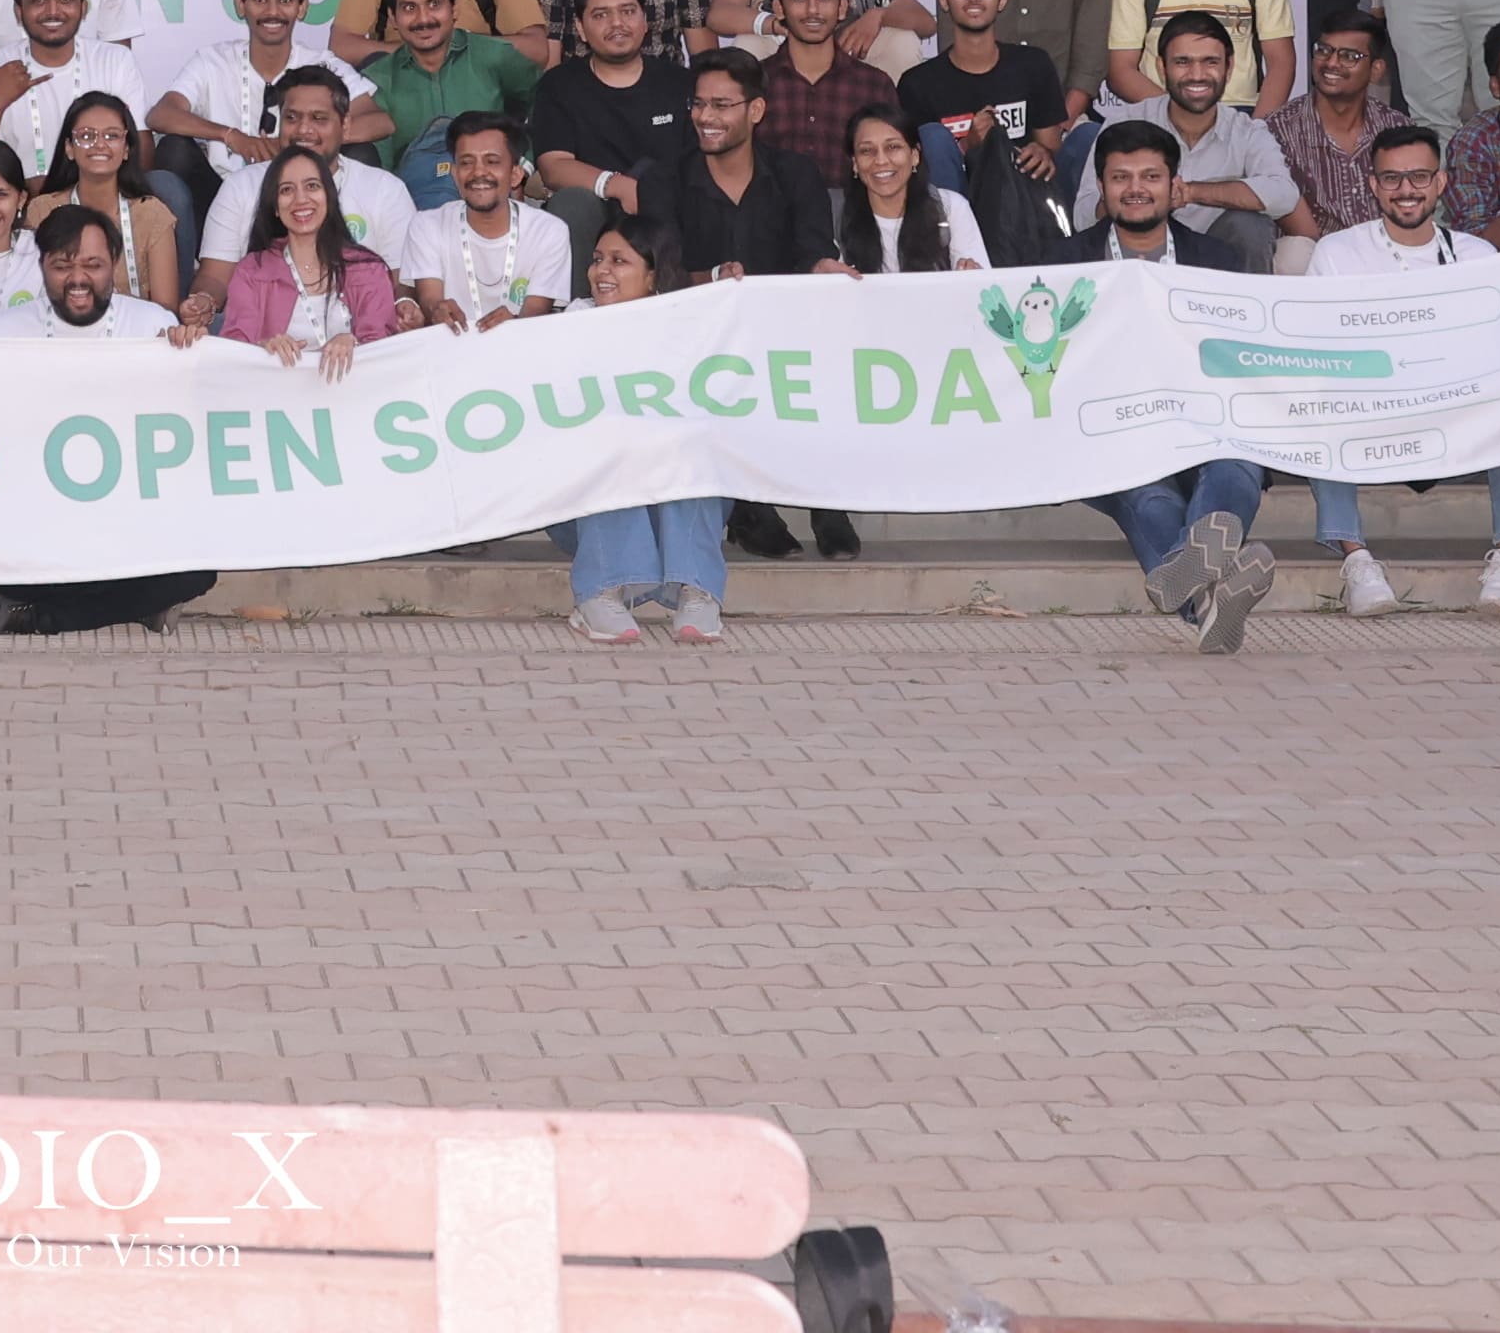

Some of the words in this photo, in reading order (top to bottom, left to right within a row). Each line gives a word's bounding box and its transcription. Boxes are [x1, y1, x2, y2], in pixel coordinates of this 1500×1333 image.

[1187, 299, 1248, 322] DEVOPS
[1339, 305, 1437, 328] DEVELOPERS
[1238, 351, 1354, 374] COMMUNITY
[1115, 398, 1187, 421] SECURITY
[1287, 399, 1370, 417] ARTIFICIAL
[1373, 382, 1481, 412] INTELLIGENCE
[42, 407, 343, 503] OPEN
[375, 349, 822, 475] SOURCE
[852, 343, 1070, 426] DAY
[1364, 439, 1423, 459] FUTURE
